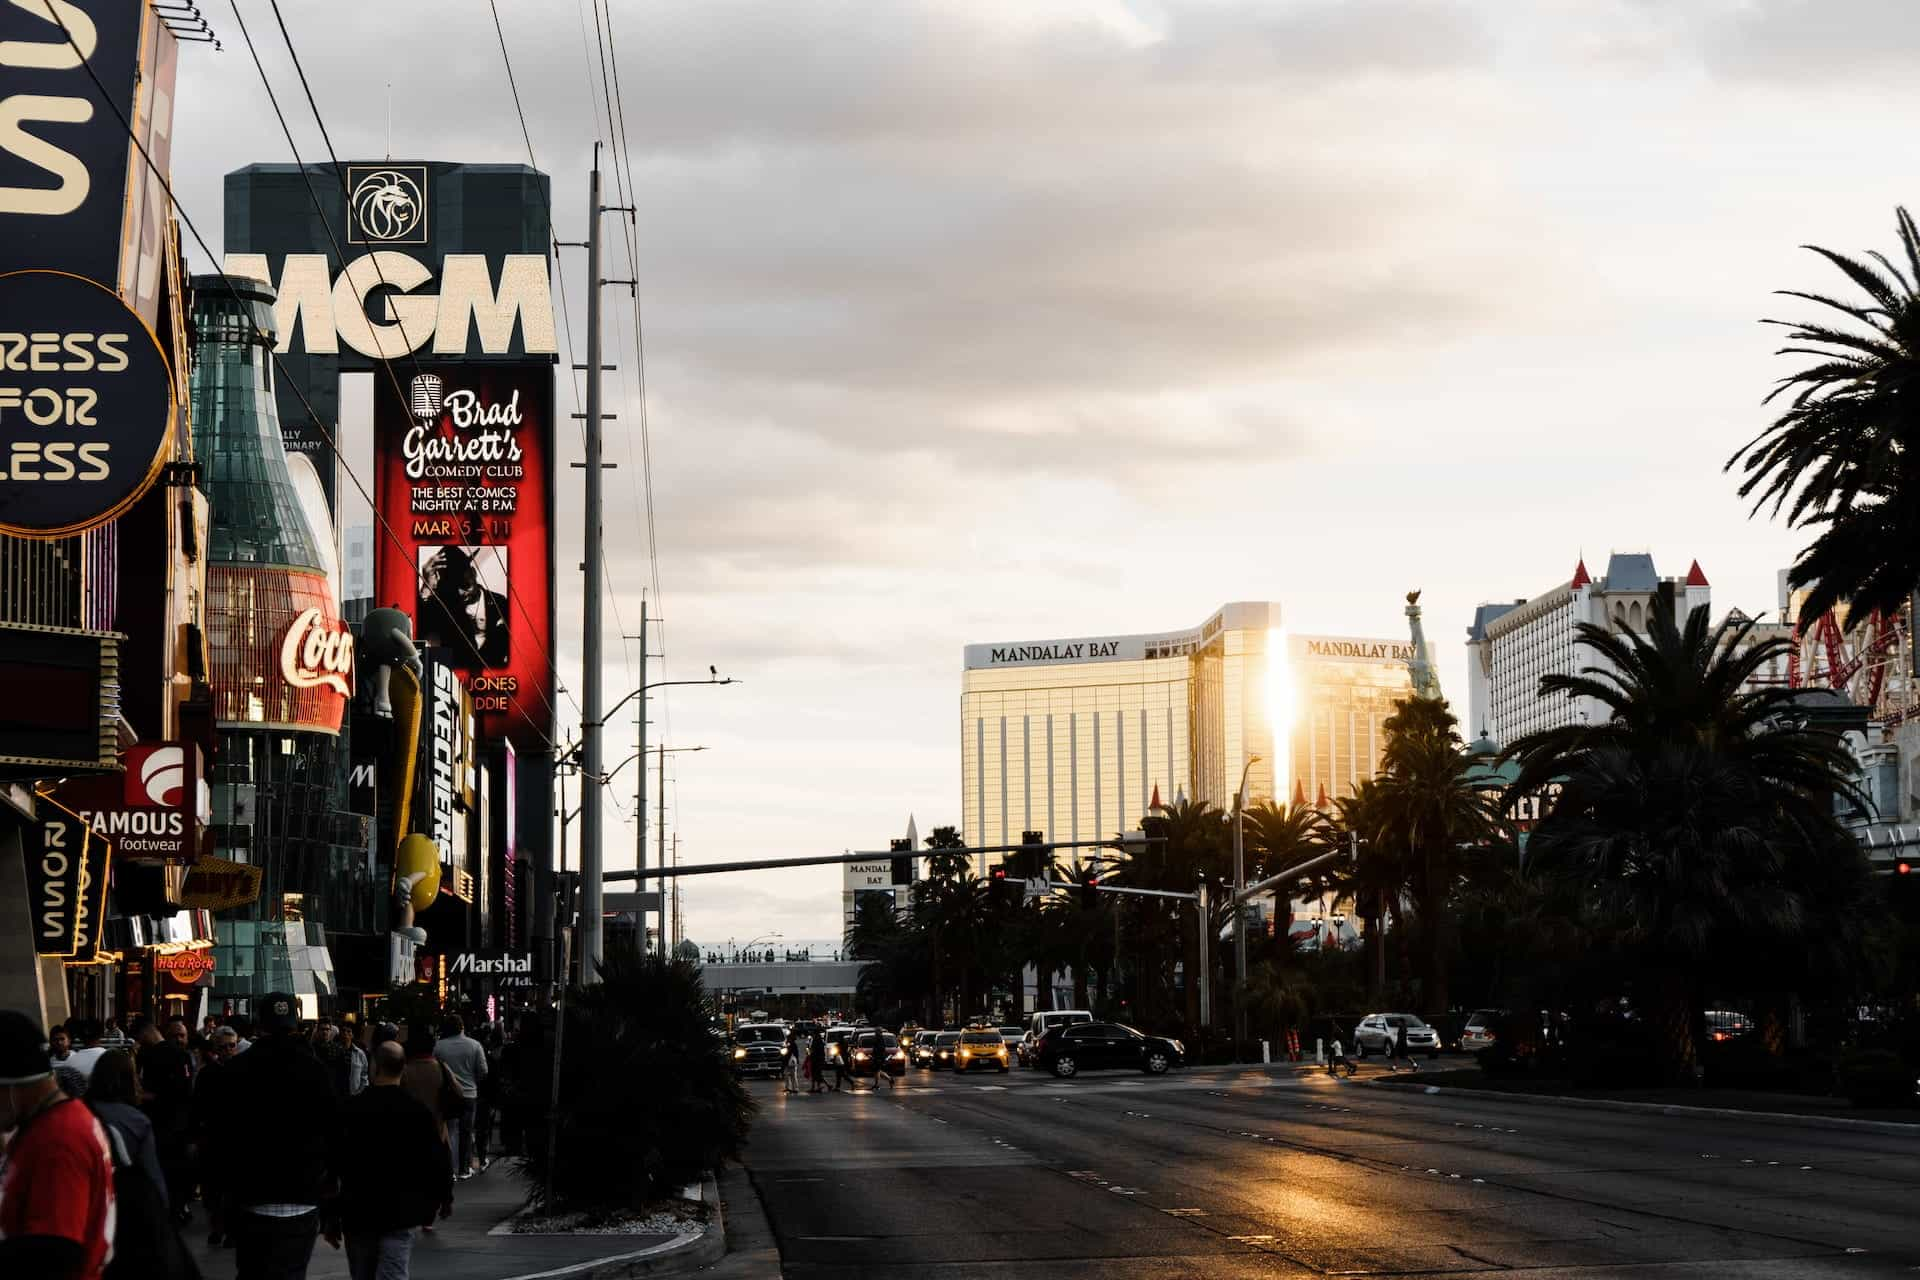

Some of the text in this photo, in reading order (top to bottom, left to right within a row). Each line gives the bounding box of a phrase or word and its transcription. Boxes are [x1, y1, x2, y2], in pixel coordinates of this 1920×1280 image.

[443, 389, 523, 428] Brad
[0, 443, 110, 481] ESS
[403, 426, 523, 478] Garrett's
[424, 465, 523, 477] COMEDY CLUB
[412, 487, 516, 498] THE BEST COMICS
[412, 500, 516, 511] NIGHTLY AT 8 P.M.
[413, 521, 455, 536] MAR.
[462, 521, 471, 535] 5
[493, 521, 510, 535] 11
[281, 607, 354, 699] Coca
[991, 641, 1120, 663] MANDALAY BAY
[1308, 640, 1417, 659] MANDALAY BAY
[469, 677, 517, 691] JONES
[433, 661, 452, 866] SKECHERS
[79, 811, 183, 835] FAMOUS
[119, 837, 182, 851] footwear
[42, 822, 68, 938] ROSS
[158, 957, 214, 971] Hard Rock
